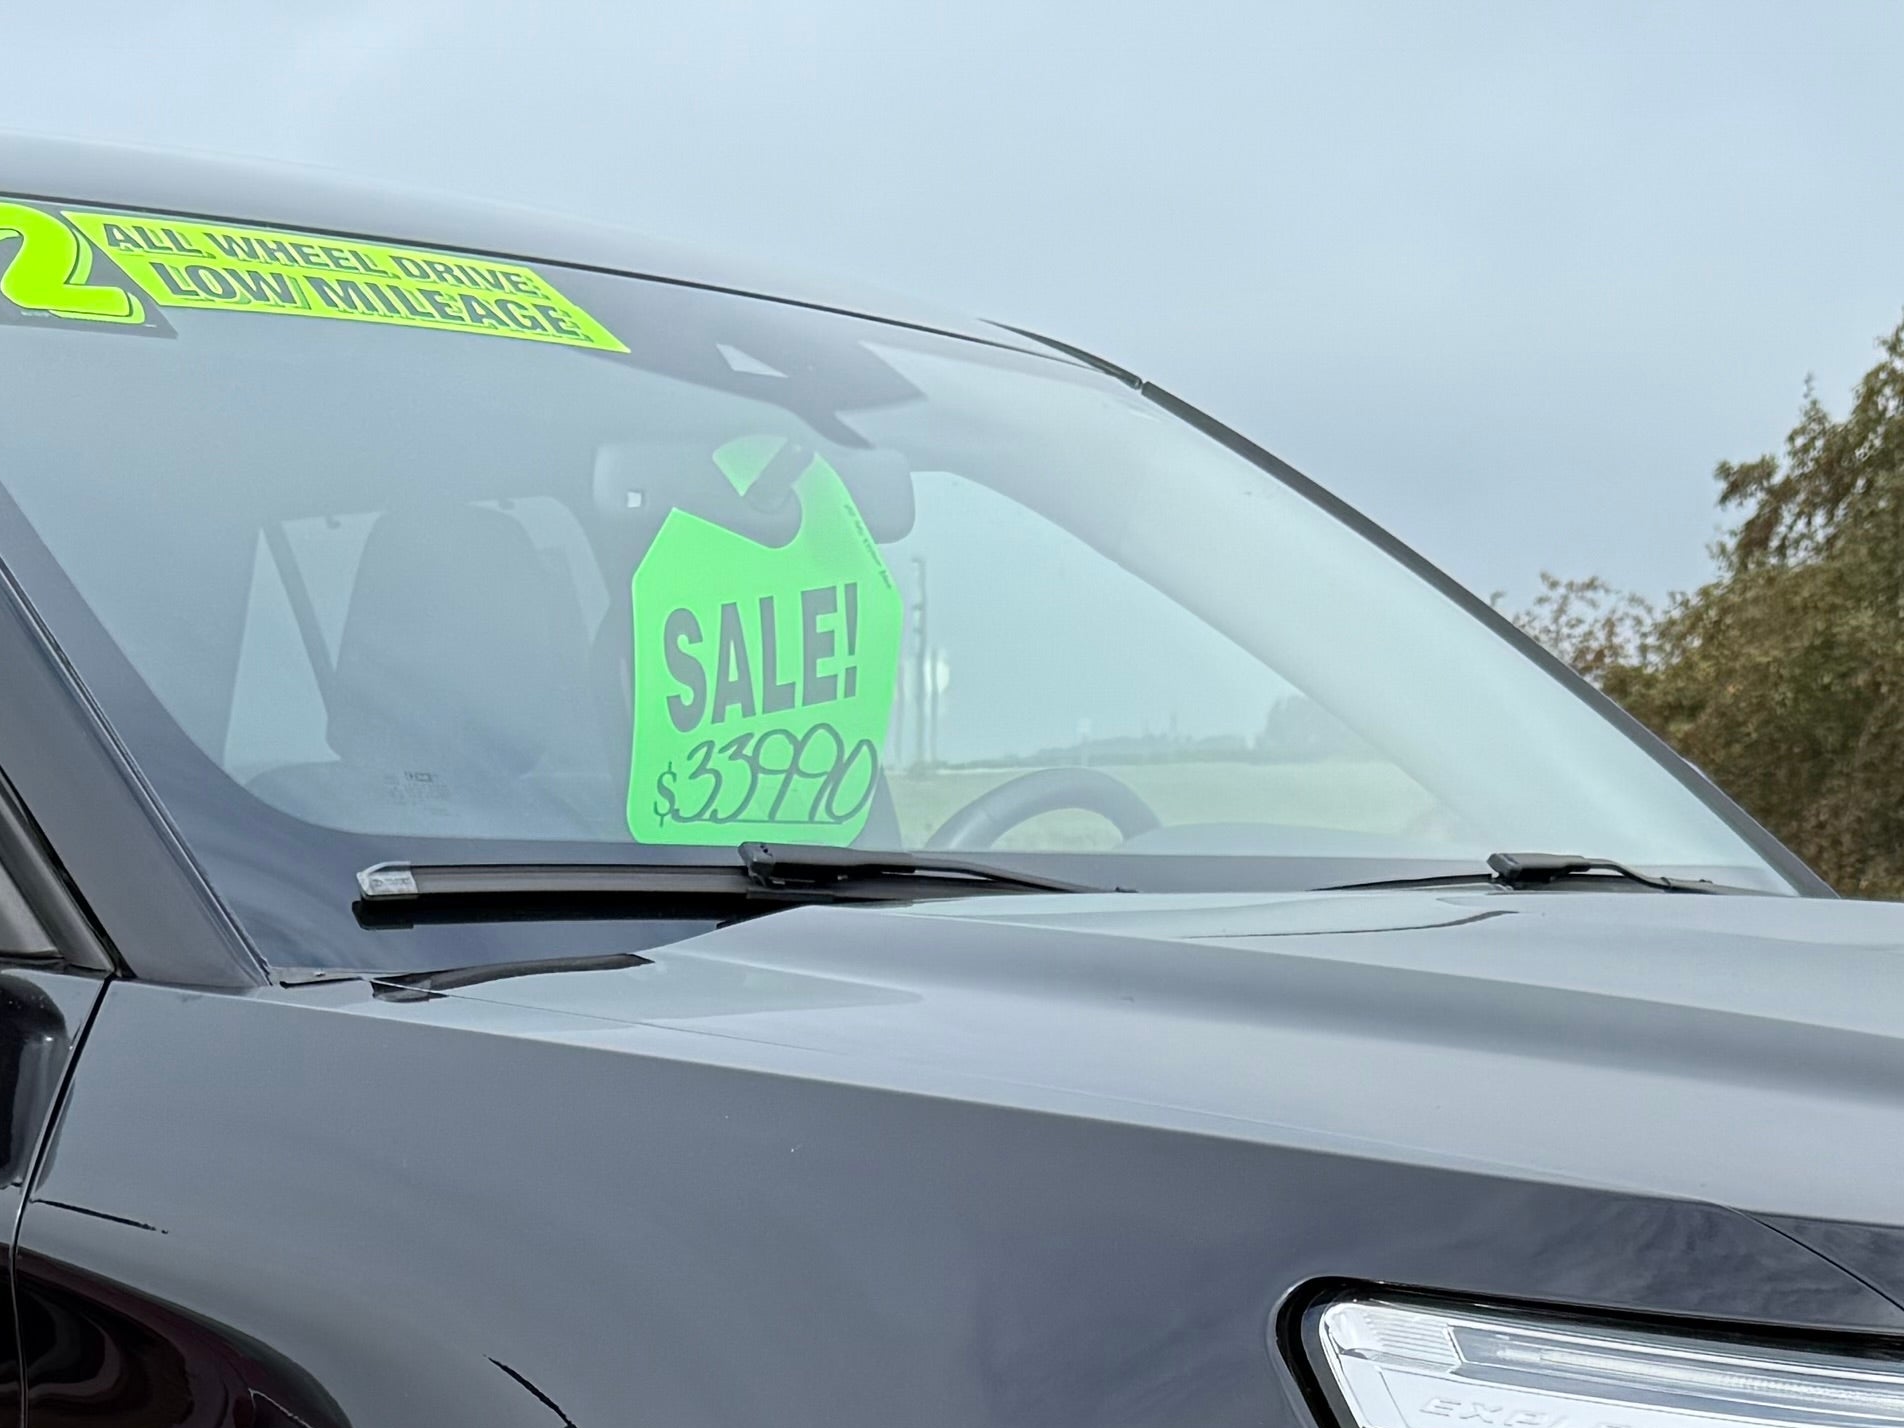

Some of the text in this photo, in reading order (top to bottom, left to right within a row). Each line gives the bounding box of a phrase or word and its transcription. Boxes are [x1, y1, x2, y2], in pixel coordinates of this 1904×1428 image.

[103, 223, 544, 298] ALL WHEEL DRIVE
[149, 261, 584, 339] LOW MILEAGE
[663, 582, 859, 733] SALE!
